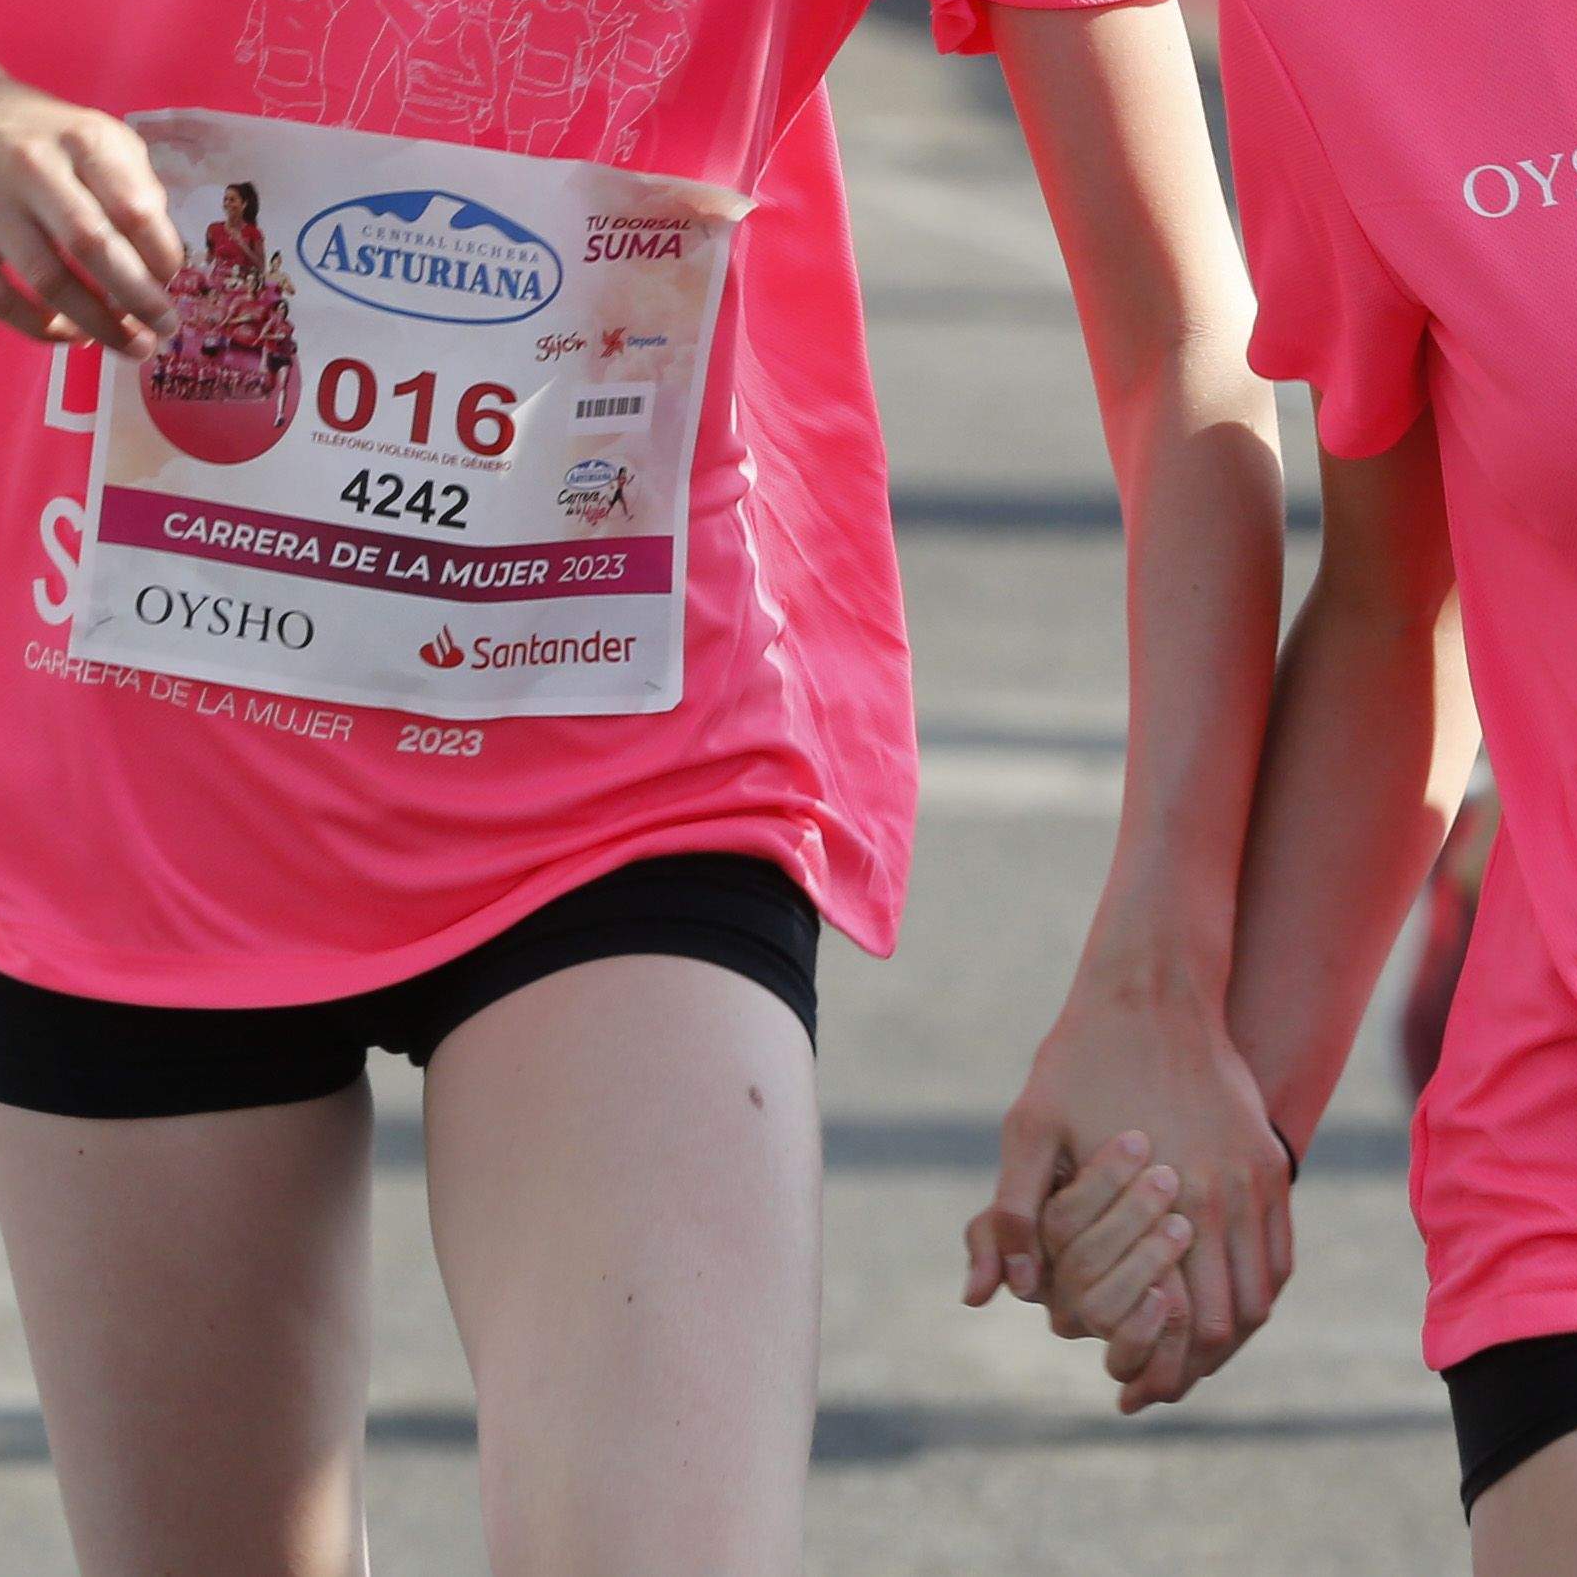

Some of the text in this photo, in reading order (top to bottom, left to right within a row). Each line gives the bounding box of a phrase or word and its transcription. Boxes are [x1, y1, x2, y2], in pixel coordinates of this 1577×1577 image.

[361, 225, 541, 264] CENTRAL LECHERA
[583, 232, 684, 263] SUMA
[585, 215, 692, 232] TU DORSAL
[314, 222, 544, 302] ASTURIANA
[316, 356, 518, 458] 016
[375, 441, 439, 464] VIOLENCIA
[441, 452, 458, 467] DE
[339, 468, 471, 530] 4242
[163, 511, 628, 589] CARRERA DE LA MUJER 2023
[134, 583, 315, 651] OYSHO
[471, 628, 638, 670] Santander
[149, 672, 191, 709] DE
[196, 683, 236, 719] LA
[243, 697, 354, 743] MUJER
[396, 723, 485, 757] 2023
